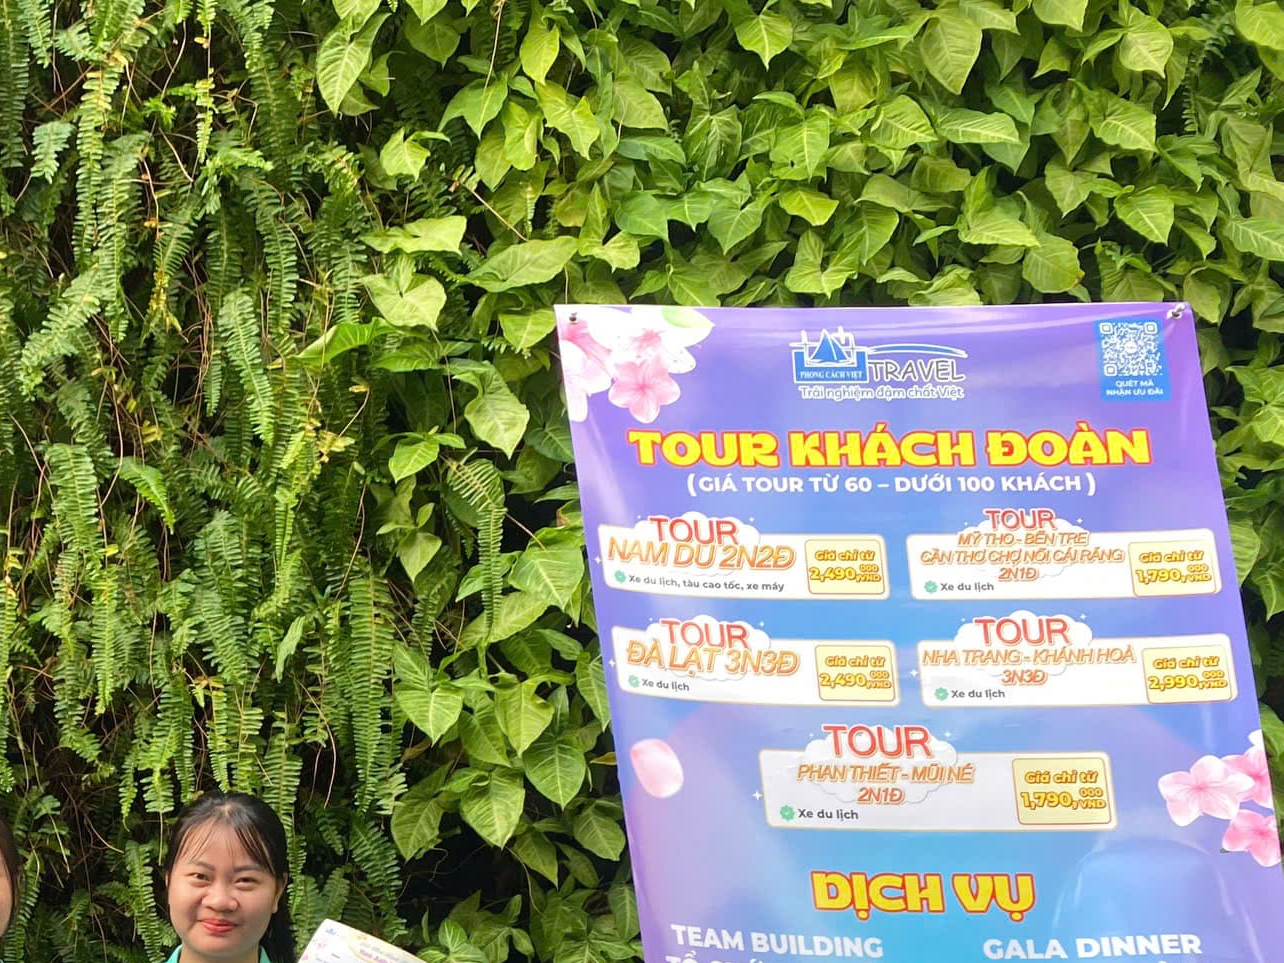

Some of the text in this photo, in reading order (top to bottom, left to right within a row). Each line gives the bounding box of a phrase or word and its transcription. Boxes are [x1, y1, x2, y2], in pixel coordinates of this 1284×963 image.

[868, 359, 965, 382] TRAVEL
[627, 421, 1152, 468] TOUR KHÁCH ĐOÀN
[742, 476, 804, 493] TOUR
[809, 473, 839, 493] TỪ
[845, 477, 872, 492] 60
[895, 472, 952, 493] DƯỚI
[957, 476, 994, 492] 100
[648, 517, 739, 545] TOUR
[608, 536, 796, 570] NAM DU 2N2Đ
[628, 575, 641, 583] Xe
[644, 577, 656, 585] du
[683, 580, 700, 588] tàu
[723, 580, 744, 591] tốc,
[761, 582, 784, 592] máy
[1025, 771, 1098, 785] Giá chỉ từ
[810, 871, 1035, 922] DỊCH VỤ
[670, 924, 883, 958] TEAM BUILDING
[983, 934, 1202, 961] GALA DINNER
